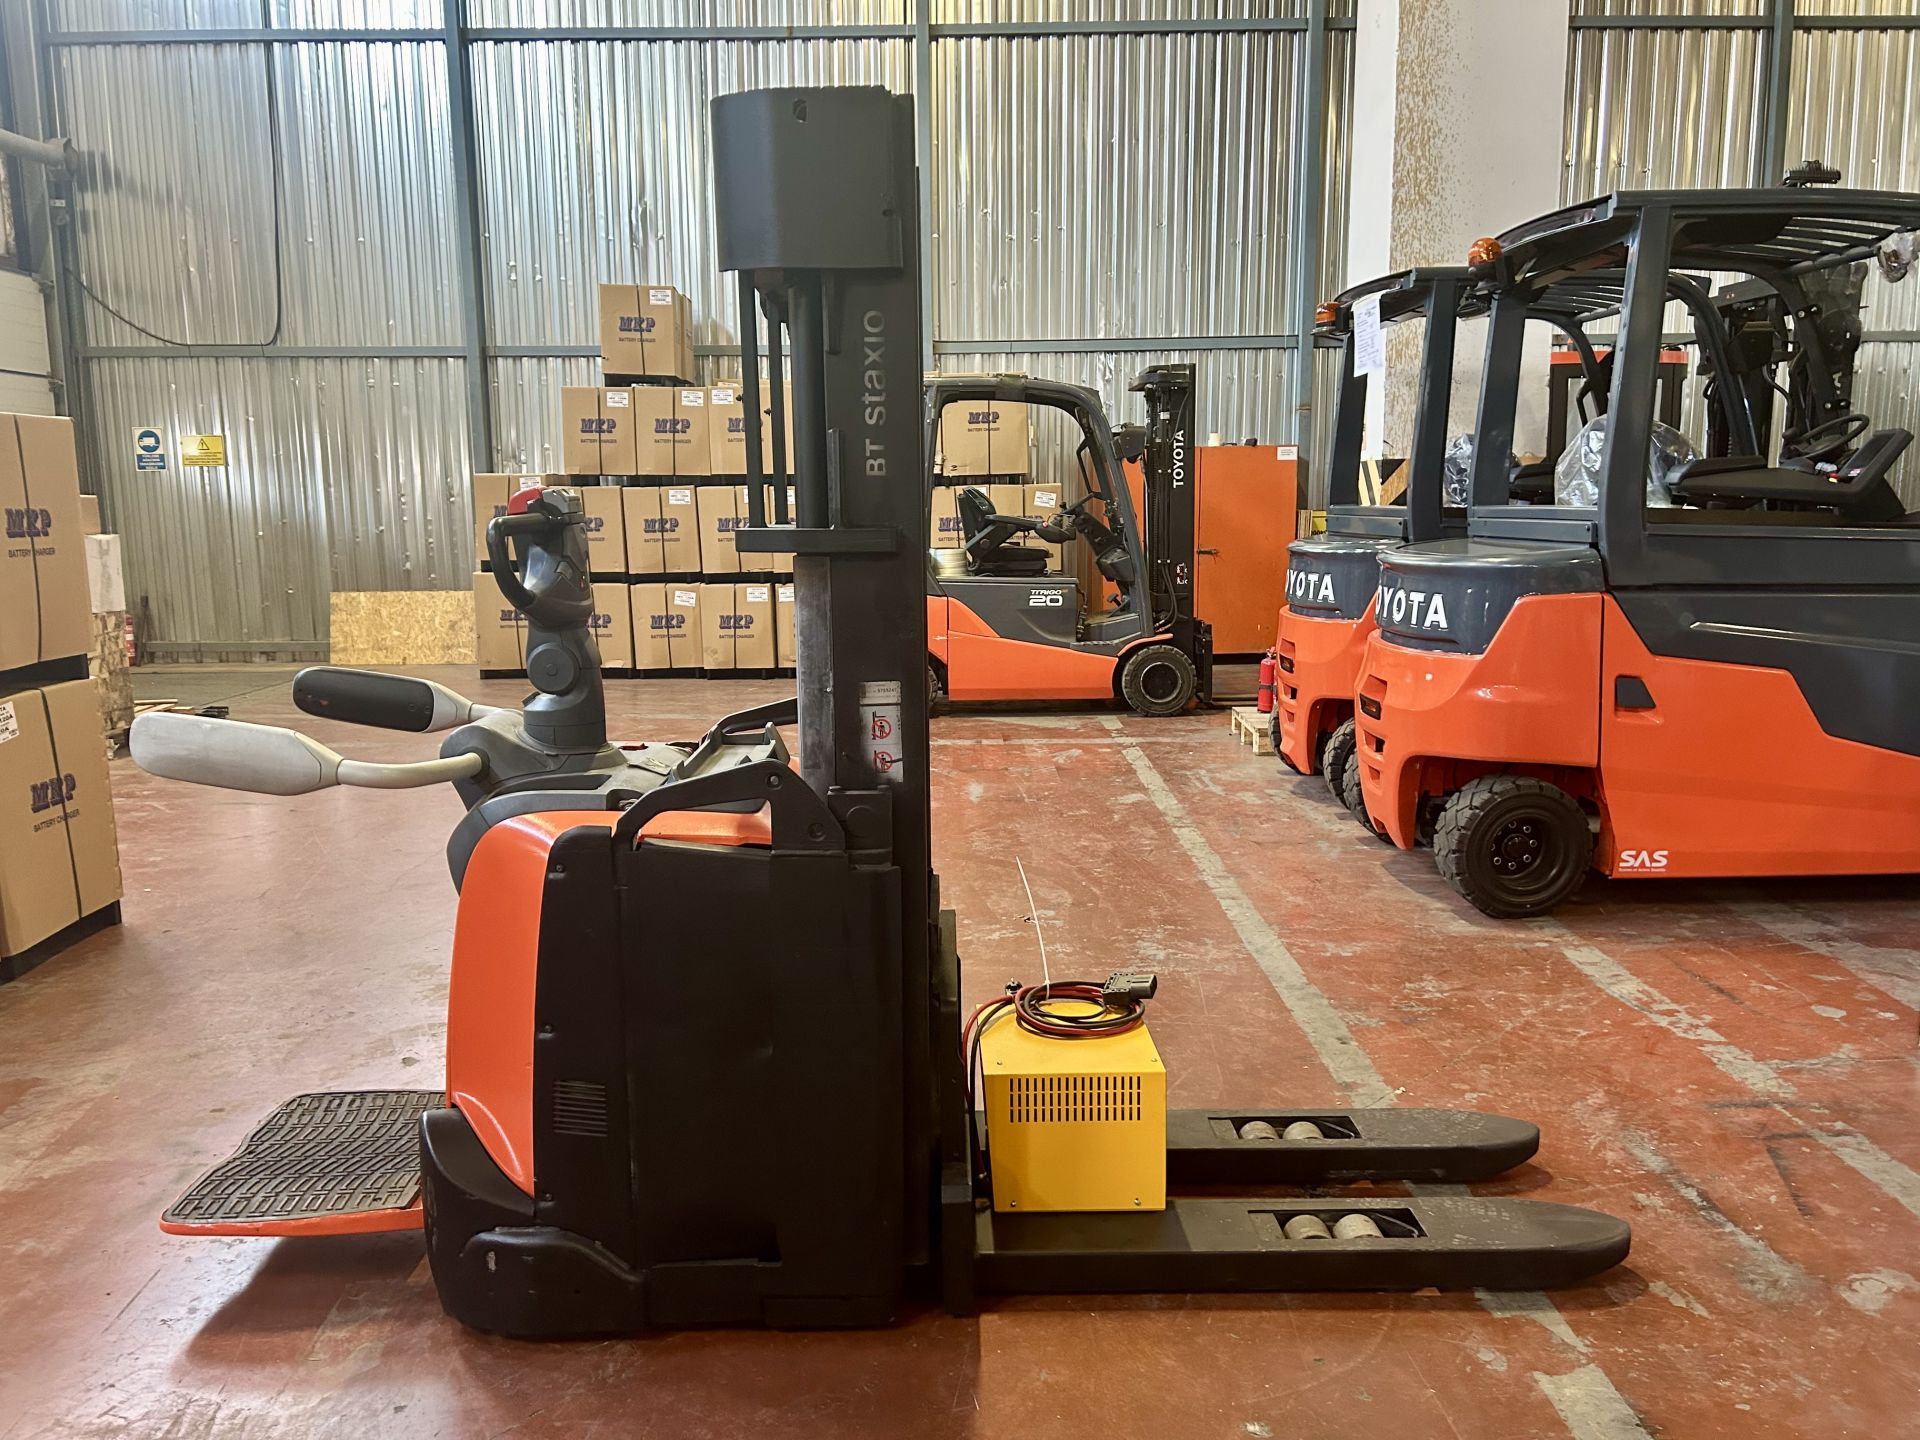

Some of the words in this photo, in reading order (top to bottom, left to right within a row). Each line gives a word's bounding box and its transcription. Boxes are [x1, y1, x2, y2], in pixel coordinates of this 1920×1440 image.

[865, 438, 886, 476] BT
[1172, 430, 1184, 488] TOYOTA
[8, 549, 32, 557] BATTERY
[1029, 595, 1063, 607] 20
[33, 817, 57, 832] BATTERY
[1619, 850, 1669, 867] SAS
